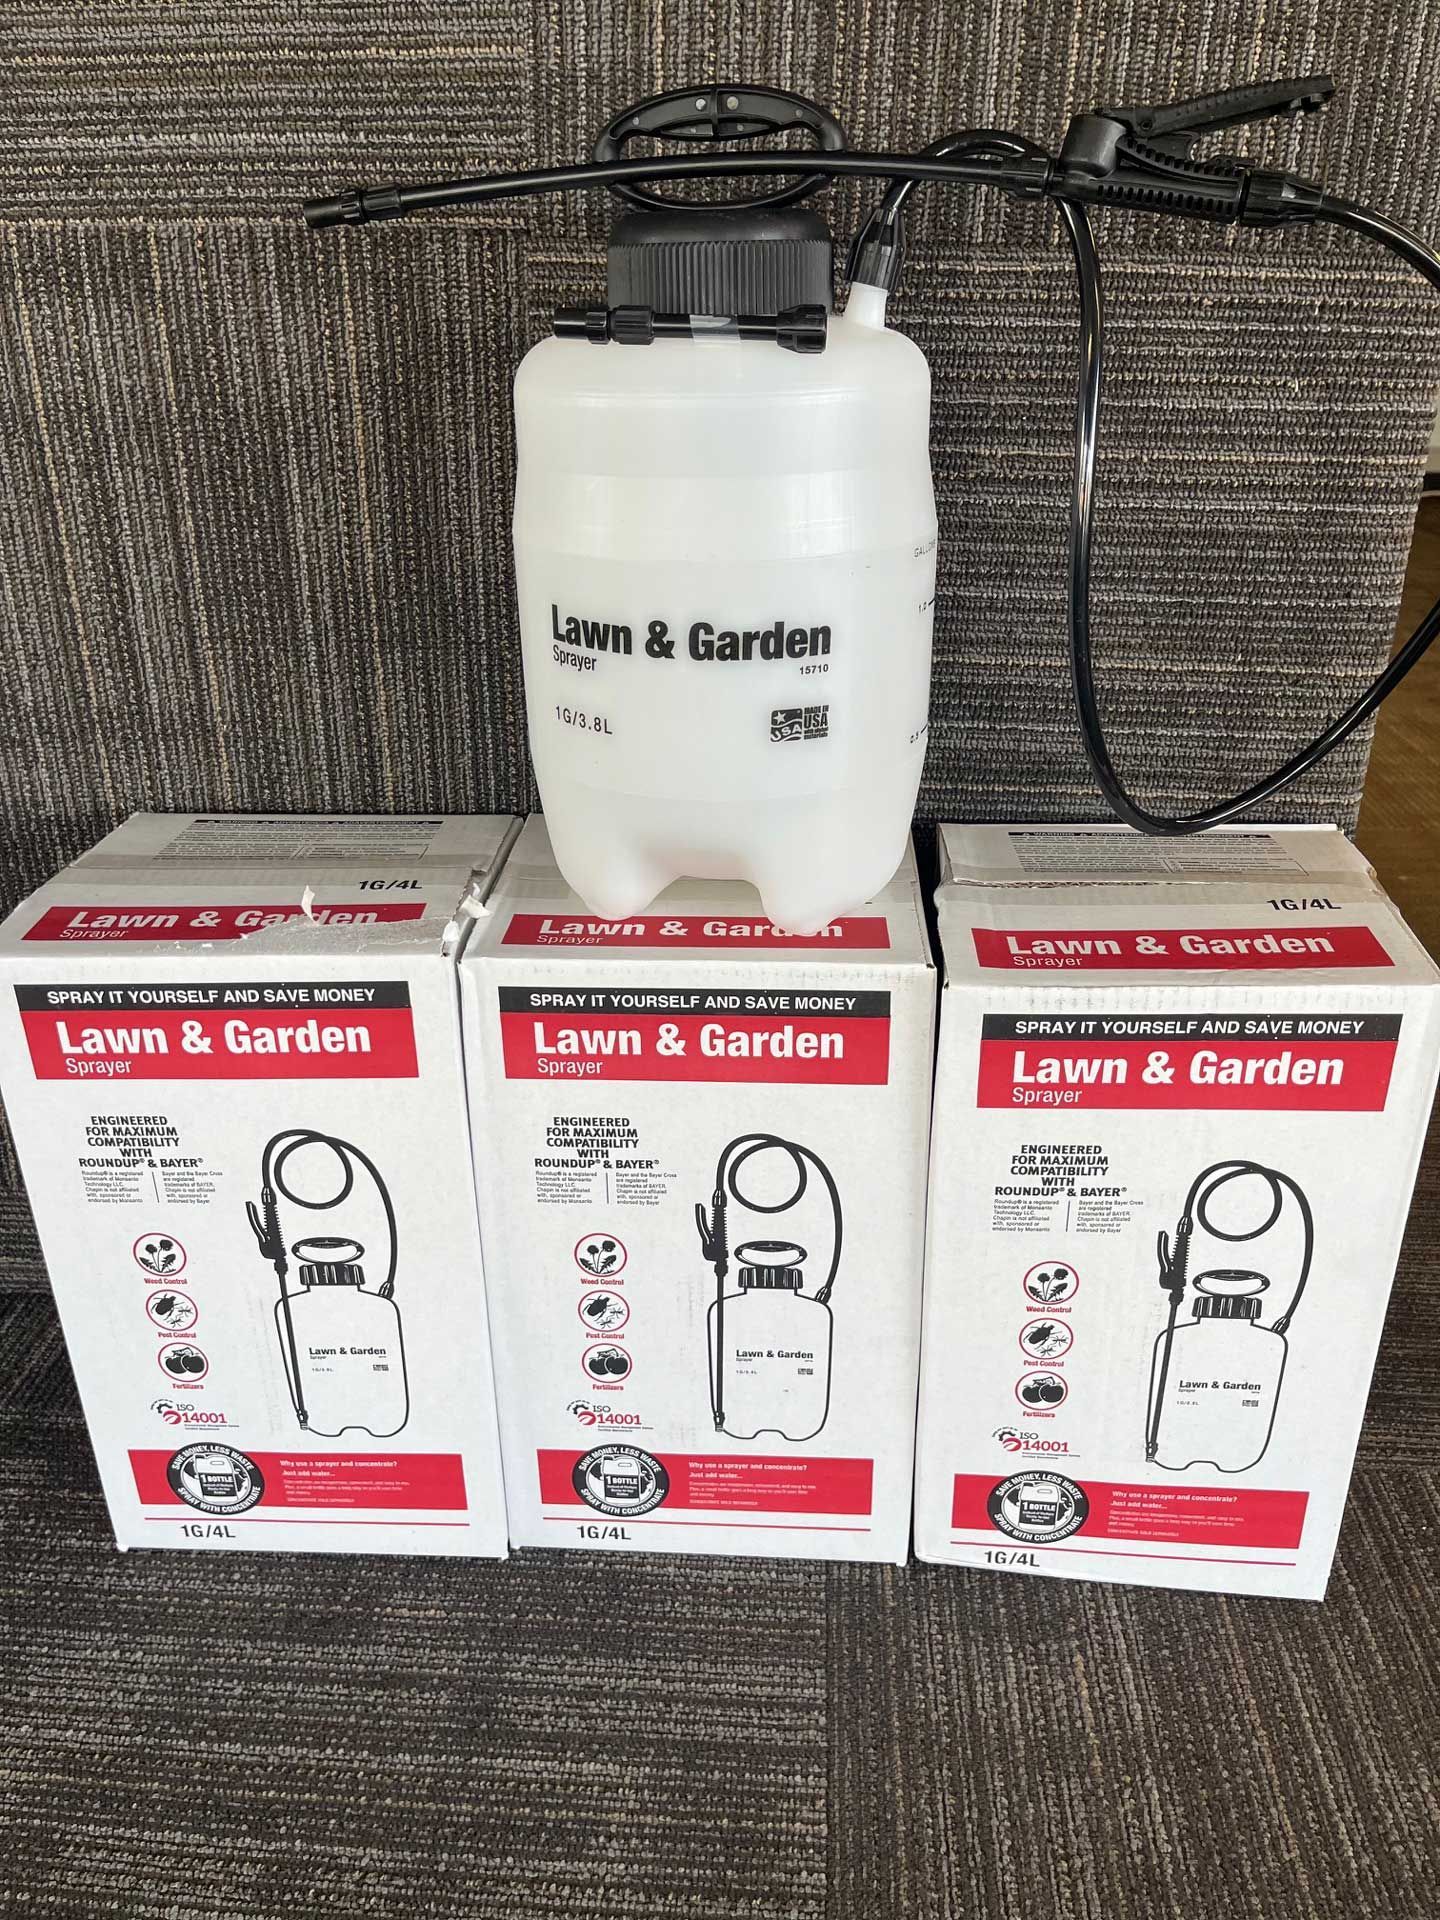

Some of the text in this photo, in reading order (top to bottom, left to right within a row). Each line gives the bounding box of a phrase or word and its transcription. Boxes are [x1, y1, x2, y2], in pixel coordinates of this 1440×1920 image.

[552, 604, 831, 661] Lawn & Garden
[553, 645, 596, 672] Sprayer
[800, 664, 829, 674] 15710
[556, 706, 612, 735] 1G/3.8L
[804, 712, 828, 729] USA
[359, 880, 422, 890] 1G/4L
[1267, 899, 1342, 911] 1G/4L
[68, 912, 175, 928] Lawn
[188, 912, 218, 927] &
[539, 919, 644, 937] Lawn
[660, 921, 688, 937] &
[59, 929, 128, 940] Sprayer
[536, 935, 603, 945] Sprayer
[1006, 935, 1334, 955] Lawn & Garden
[1013, 956, 1082, 967] Sprayer
[47, 988, 375, 1004] SPRAY IT YOURSELF AND SAVE MONEY
[530, 994, 856, 1010] SPRAY IT YOURSELF AND SAVE MONEY
[1015, 1021, 1365, 1034] SPRAY IT YOURSELF AND SAVE MONEY
[56, 1019, 371, 1054] Lawn & Garden
[533, 1022, 844, 1058] Lawn & Garden
[65, 1058, 131, 1078] Sprayer
[537, 1058, 603, 1076] Sprayer
[1012, 1050, 1343, 1085] Lawn & Garden
[1012, 1086, 1082, 1104] Sprayer
[91, 1116, 168, 1125] ENGINEERED
[553, 1117, 630, 1126] ENGINEERED
[86, 1127, 177, 1136] FOR MAXIMUM
[547, 1128, 638, 1137] FOR MAXIMUM
[87, 1137, 180, 1147] COMPATIBILITY
[546, 1138, 639, 1148] COMPATIBILITY
[119, 1148, 152, 1157] WITH
[577, 1149, 609, 1158] WITH
[1021, 1145, 1102, 1154] ENGINEERED
[148, 1159, 158, 1168] &
[603, 1160, 612, 1169] &
[1012, 1156, 1108, 1165] FOR MAXIMUM
[1011, 1166, 1109, 1176] COMPATIBILITY
[1042, 1177, 1075, 1186] WITH
[1067, 1188, 1076, 1197] &
[309, 1347, 386, 1355] Lawn & Garden
[736, 1349, 813, 1358] Lawn & Garden
[1180, 1380, 1261, 1390] Lawn & Garden
[177, 1403, 194, 1412] ISO
[593, 1404, 610, 1413] ISO
[183, 1413, 227, 1423] 14001
[597, 1414, 641, 1425] 14001
[1019, 1432, 1038, 1440] ISO
[1022, 1441, 1069, 1452] 14001
[171, 1452, 187, 1470] SAVE
[210, 1445, 231, 1455] LESS
[231, 1451, 255, 1470] WASTE
[579, 1455, 592, 1471] SAVE
[620, 1447, 640, 1457] LESS
[640, 1453, 661, 1472] WASTE
[201, 1474, 206, 1482] 1
[606, 1476, 611, 1484] 1
[996, 1481, 1013, 1496] SAVE
[1042, 1473, 1063, 1484] LESS
[1062, 1480, 1083, 1500] WASTE
[178, 1487, 200, 1505] SPRAY
[200, 1502, 220, 1512] WITH
[222, 1486, 261, 1512] CONCENTRATE
[581, 1488, 601, 1506] SPRAY
[600, 1504, 620, 1514] WITH
[622, 1488, 664, 1514] CONCENTRATE
[1022, 1502, 1028, 1510] 1
[181, 1525, 236, 1538] 1G/4L
[577, 1525, 632, 1540] 1G/4L
[994, 1513, 1014, 1531] SPRAY
[1012, 1530, 1032, 1540] WITH
[1034, 1515, 1083, 1541] CONCENTRATE
[984, 1551, 1040, 1567] 1G/4L
